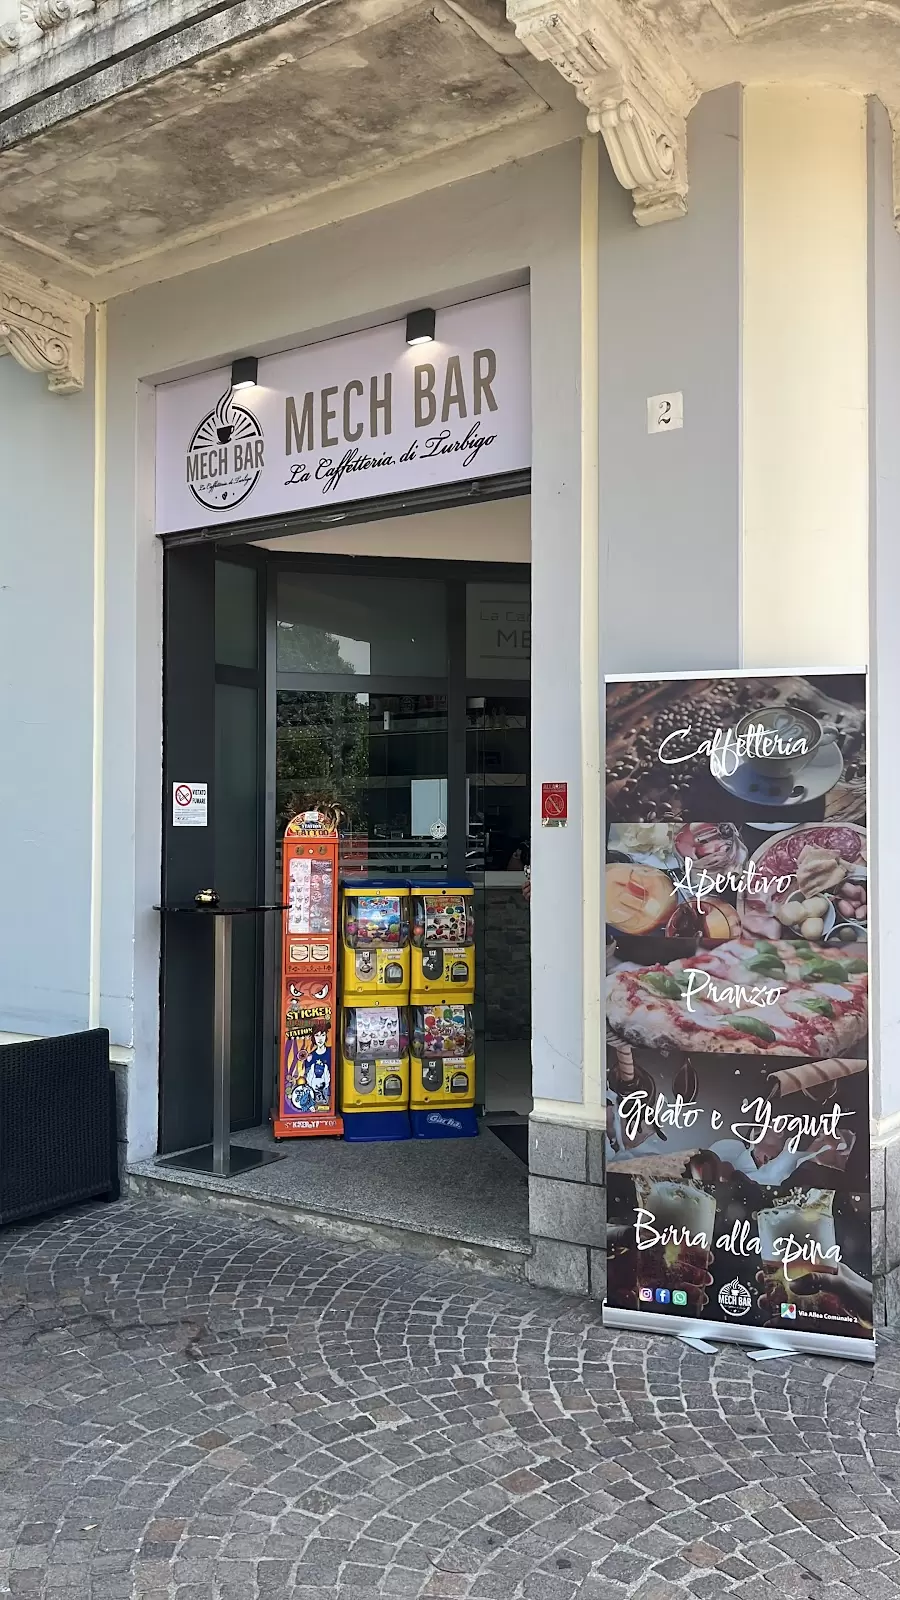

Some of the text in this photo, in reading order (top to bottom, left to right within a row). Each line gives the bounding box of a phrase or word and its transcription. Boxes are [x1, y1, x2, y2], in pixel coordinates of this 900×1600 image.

[285, 348, 499, 455] MECH BAR
[658, 400, 671, 424] 2
[186, 439, 264, 482] MECH BAR
[284, 421, 498, 494] La Caffetteria di Turbigo
[658, 723, 809, 778] Caffetteria
[669, 856, 798, 914] Aperitivo
[680, 968, 787, 1013] Pranzo
[285, 1027, 313, 1038] STATION
[286, 1007, 332, 1020] STICKER
[617, 1090, 855, 1154] Gelato e Yogurt
[632, 1207, 843, 1282] Birra alla spina
[718, 1294, 752, 1307] MECH BAR
[823, 1313, 853, 1323] Comunale
